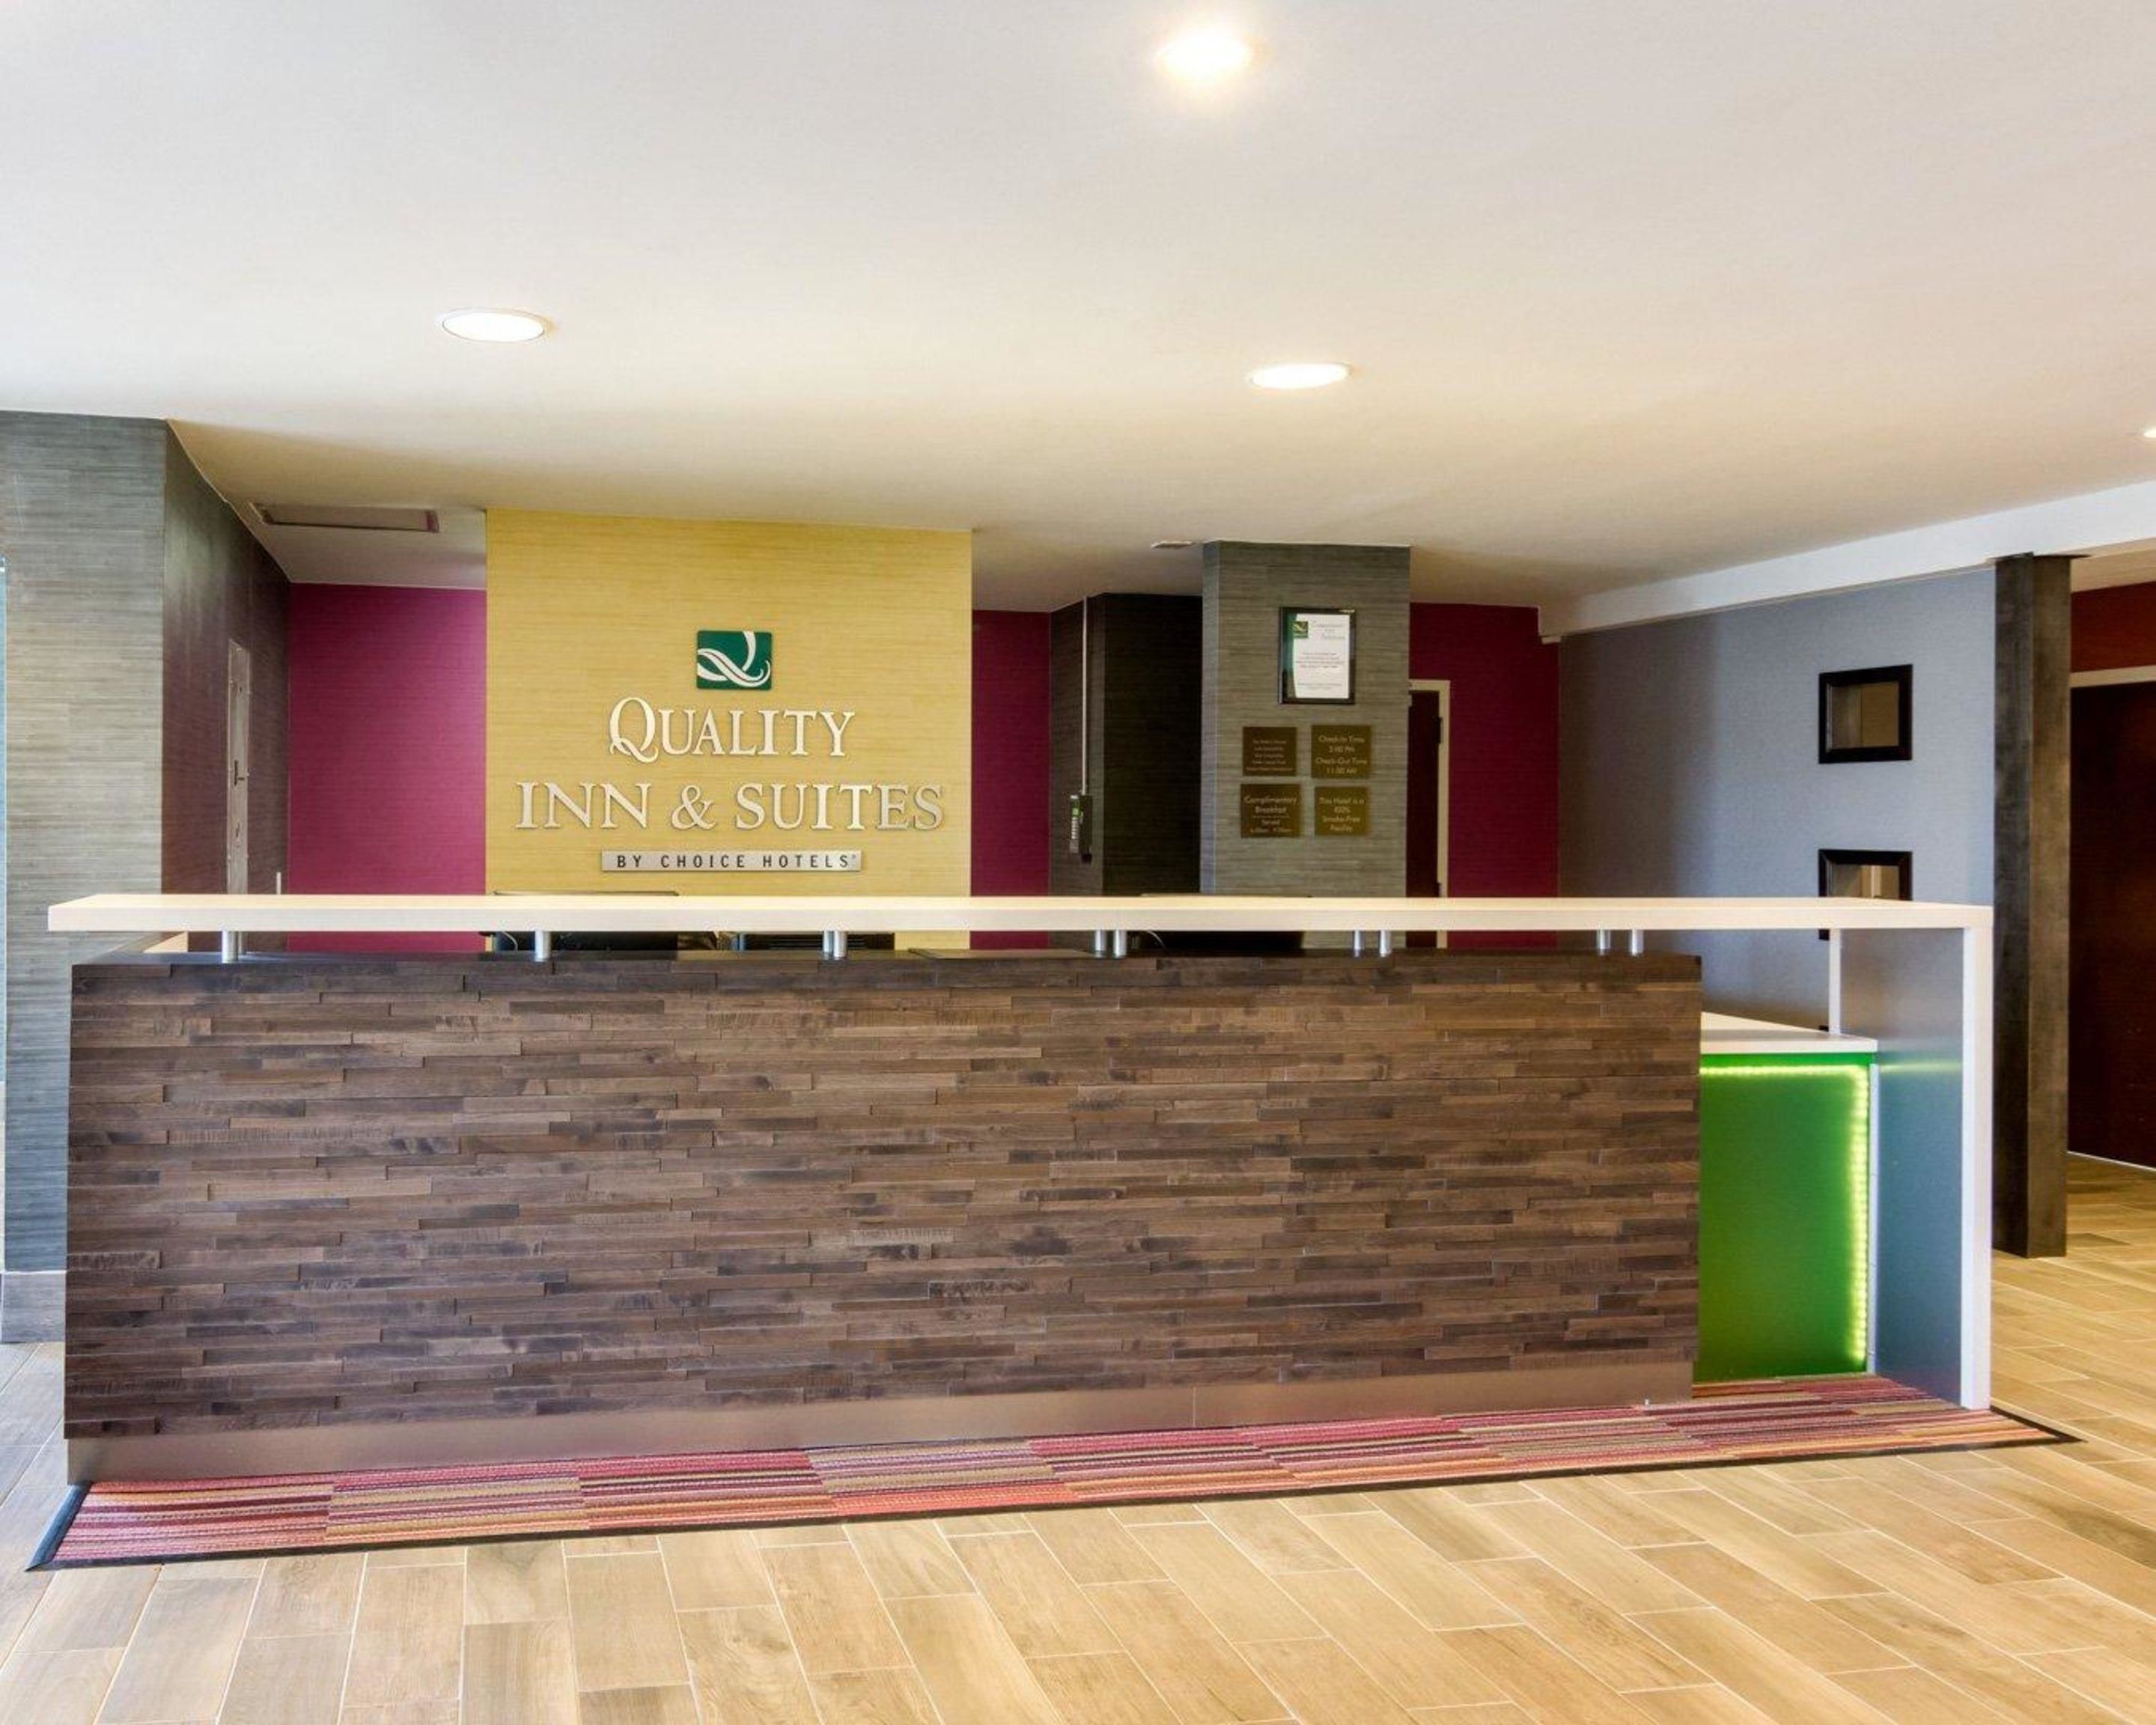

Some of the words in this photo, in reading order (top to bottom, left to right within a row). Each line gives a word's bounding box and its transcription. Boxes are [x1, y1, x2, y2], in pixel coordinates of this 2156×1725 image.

[609, 697, 855, 762] QUALITY
[516, 782, 651, 829] INN
[671, 785, 716, 830] &
[736, 782, 943, 830] SUITES
[617, 854, 642, 868] BY
[661, 854, 745, 868] CHOICE
